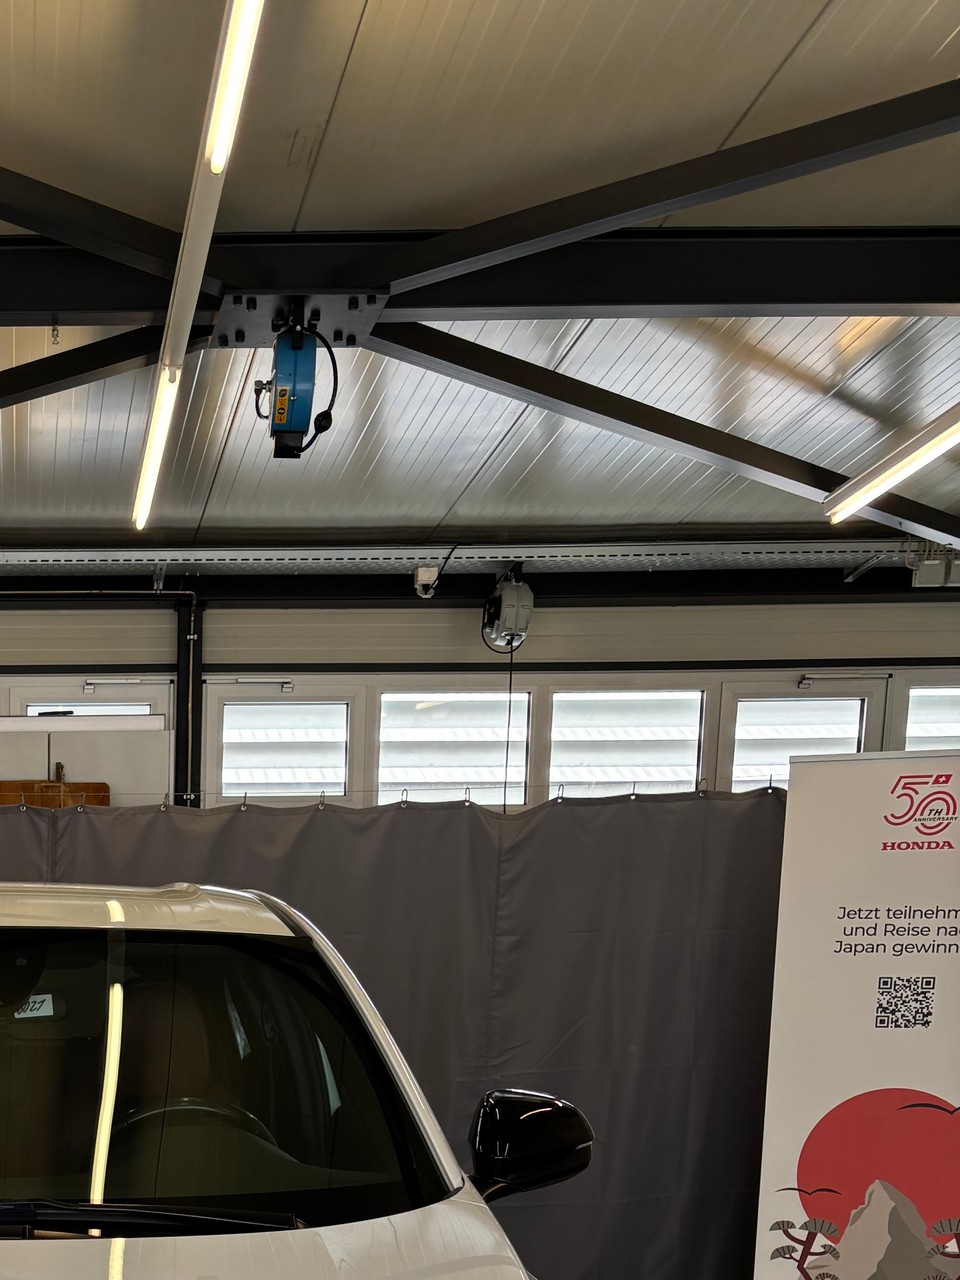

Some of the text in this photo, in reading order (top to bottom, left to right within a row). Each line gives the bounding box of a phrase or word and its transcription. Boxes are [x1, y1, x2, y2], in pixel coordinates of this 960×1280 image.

[883, 774, 958, 836] 50
[927, 808, 944, 817] TH
[881, 840, 956, 851] HONDA
[837, 906, 880, 919] Jetzt
[843, 922, 960, 936] und Reise na
[834, 940, 959, 956] Japan gewinn
